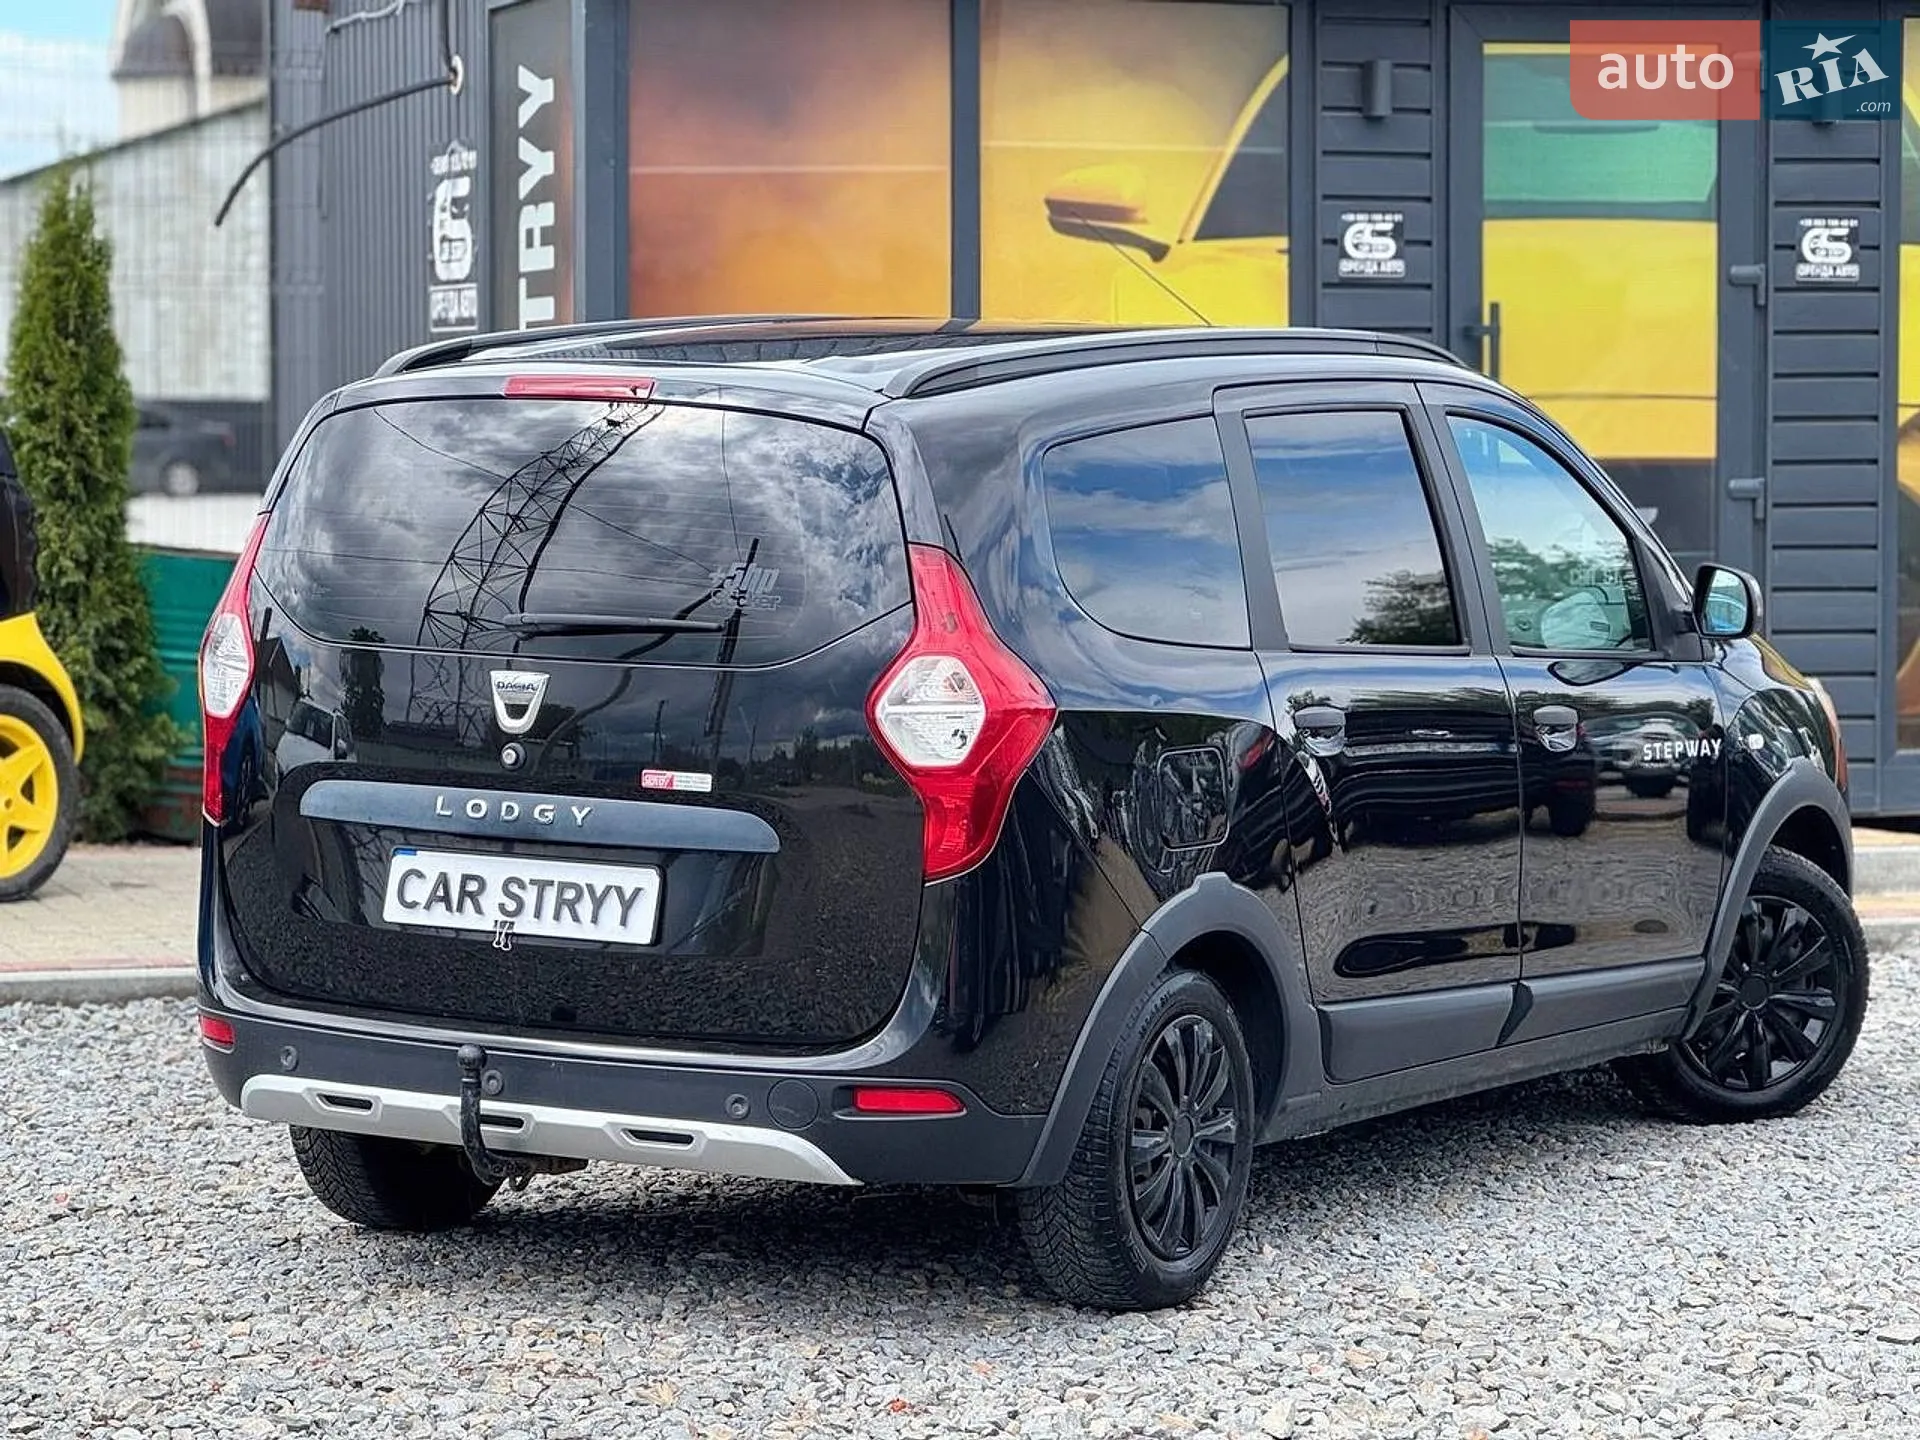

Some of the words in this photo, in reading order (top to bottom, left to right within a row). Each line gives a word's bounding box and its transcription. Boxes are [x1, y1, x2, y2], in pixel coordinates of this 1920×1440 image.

[518, 63, 556, 330] TRYY
[496, 681, 535, 692] DACIA
[1643, 738, 1722, 761] STEPWAY
[436, 796, 592, 827] LODGY
[397, 868, 487, 916] CAR
[498, 876, 644, 928] STRYY
